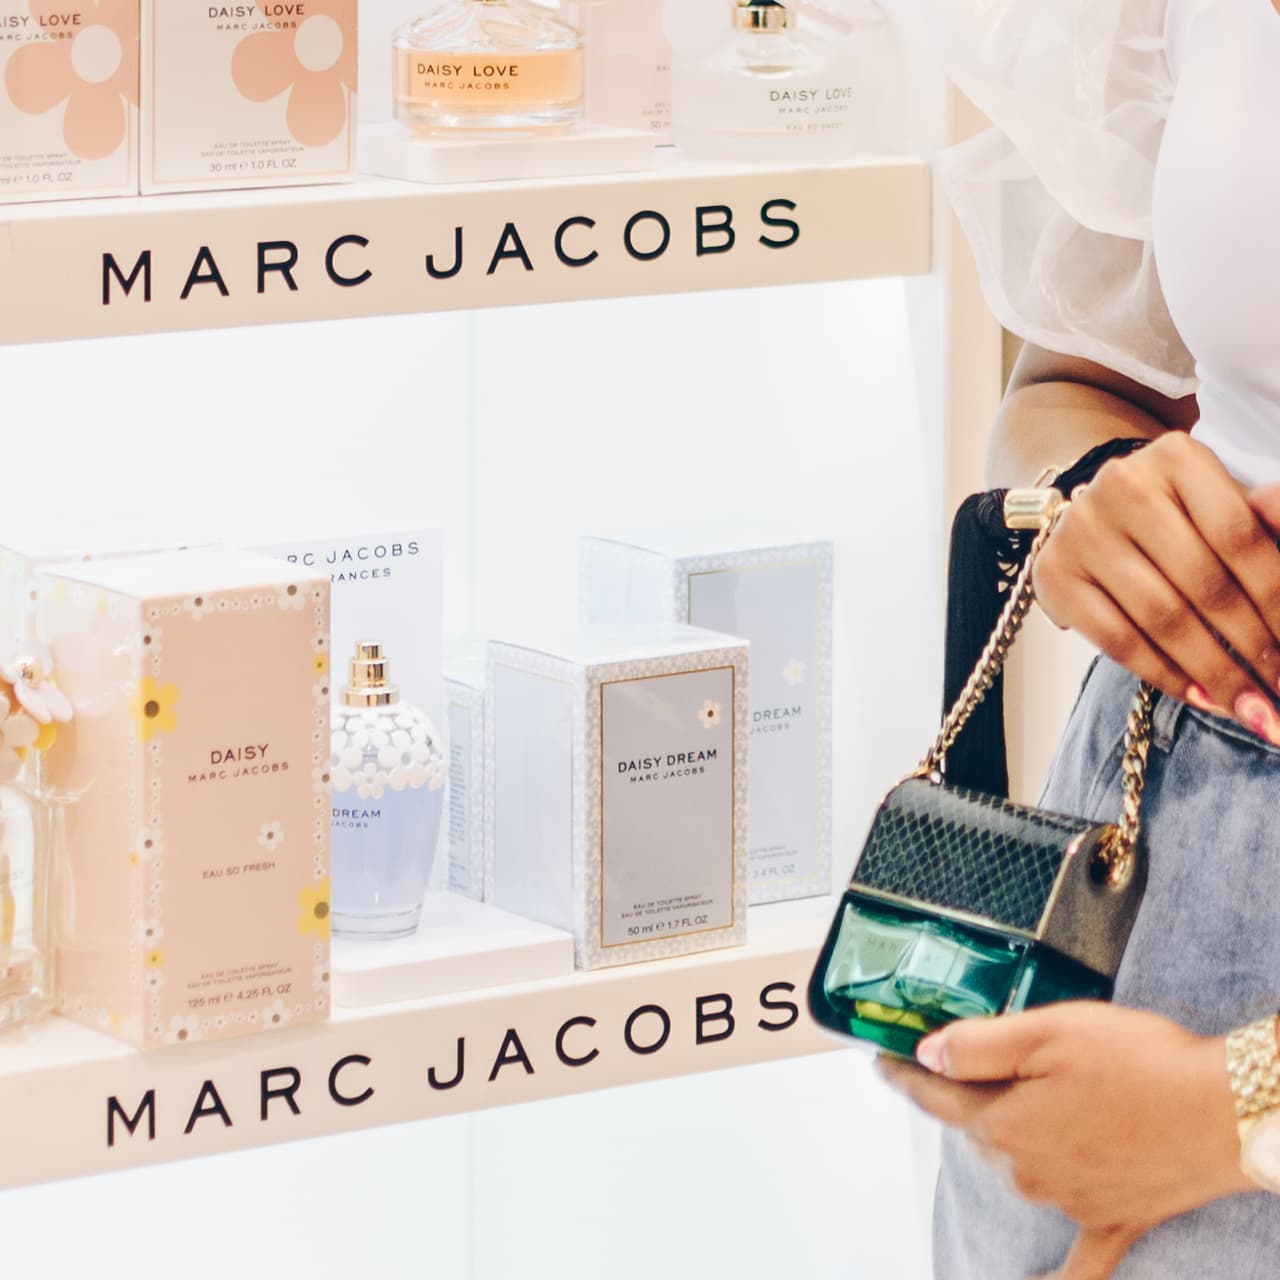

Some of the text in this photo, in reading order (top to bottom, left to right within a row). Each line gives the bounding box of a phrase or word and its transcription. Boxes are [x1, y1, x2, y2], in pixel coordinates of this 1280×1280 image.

[207, 3, 305, 19] DAISY LOVE
[39, 13, 81, 27] LOVE
[216, 21, 297, 31] MARC JACOBS
[25, 31, 74, 41] JACOBS
[417, 63, 519, 77] DAISY LOVE
[424, 81, 510, 91] MARC JACOBS
[769, 86, 853, 102] DAISY LOVE
[267, 159, 279, 169] FL
[281, 158, 297, 169] OZ
[42, 172, 55, 183] FL
[57, 171, 73, 182] OZ
[101, 197, 802, 307] MARC JACOBS
[326, 541, 420, 564] JACOBS
[752, 705, 802, 722] DREAM
[210, 743, 270, 765] DAISY
[617, 748, 718, 773] DAISY DREAM
[188, 761, 290, 783] MARC JACOBS
[630, 765, 705, 783] MARC JACOBS
[331, 807, 382, 819] DREAM
[202, 861, 277, 880] EAU SO FRESH
[627, 926, 640, 936] 50
[642, 923, 653, 934] ml
[682, 917, 693, 928] FL
[694, 914, 709, 925] OZ
[188, 997, 206, 1009] 125
[262, 985, 274, 997] FL
[276, 982, 293, 995] OZ
[107, 981, 801, 1148] MARC JACOBS
